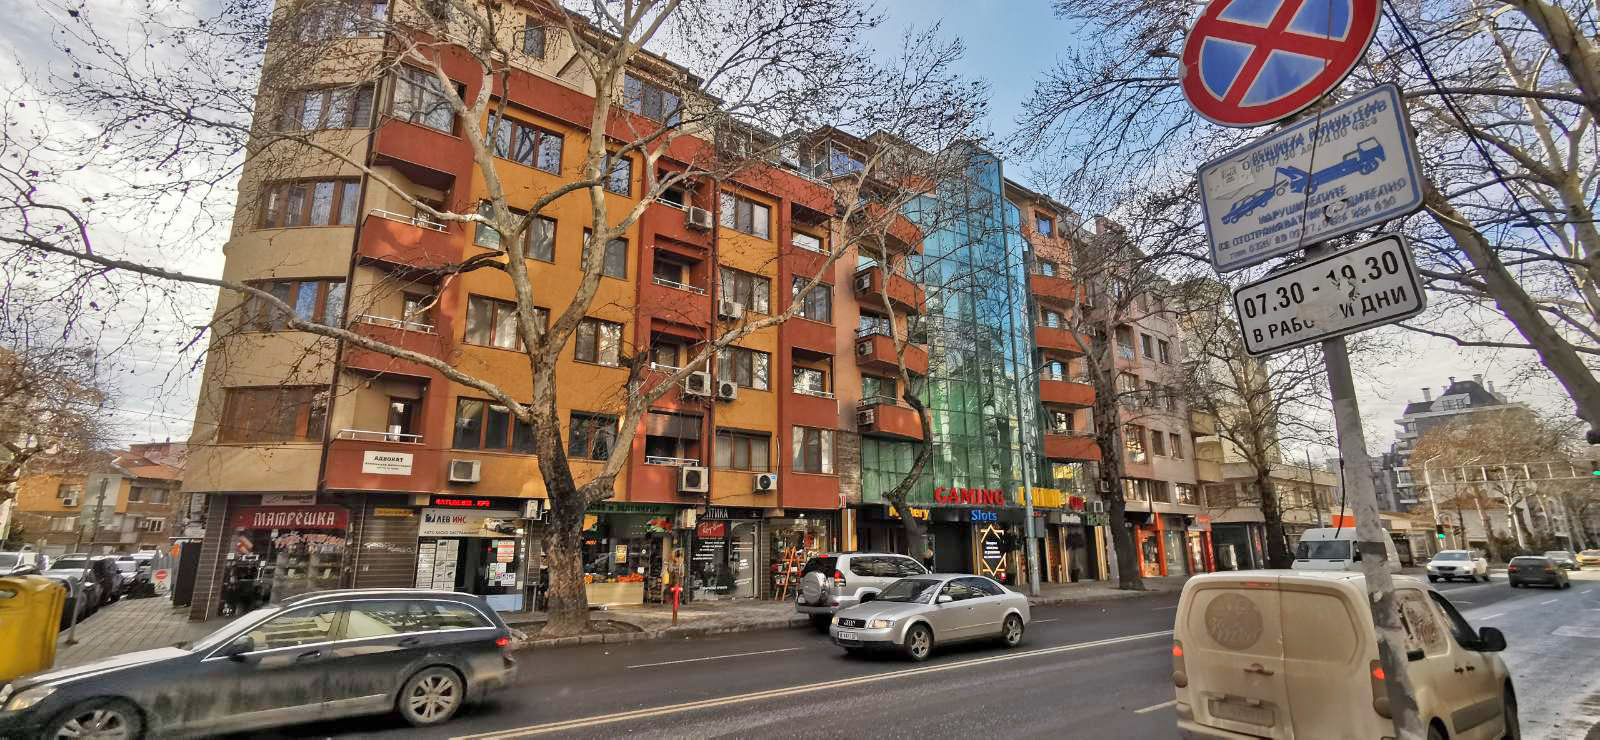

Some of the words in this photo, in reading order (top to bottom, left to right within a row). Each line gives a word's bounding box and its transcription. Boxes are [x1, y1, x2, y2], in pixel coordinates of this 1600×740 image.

[1243, 281, 1305, 319] 07.30
[1253, 328, 1264, 344] В
[1268, 302, 1355, 340] РАБОИ
[1361, 285, 1408, 318] ДНИ
[374, 455, 404, 463] АДВОКАТ
[934, 487, 1006, 506] GAMING
[252, 511, 336, 527] МАТРЕШКА
[437, 515, 451, 524] ЛЕВ
[971, 509, 998, 521] Slots
